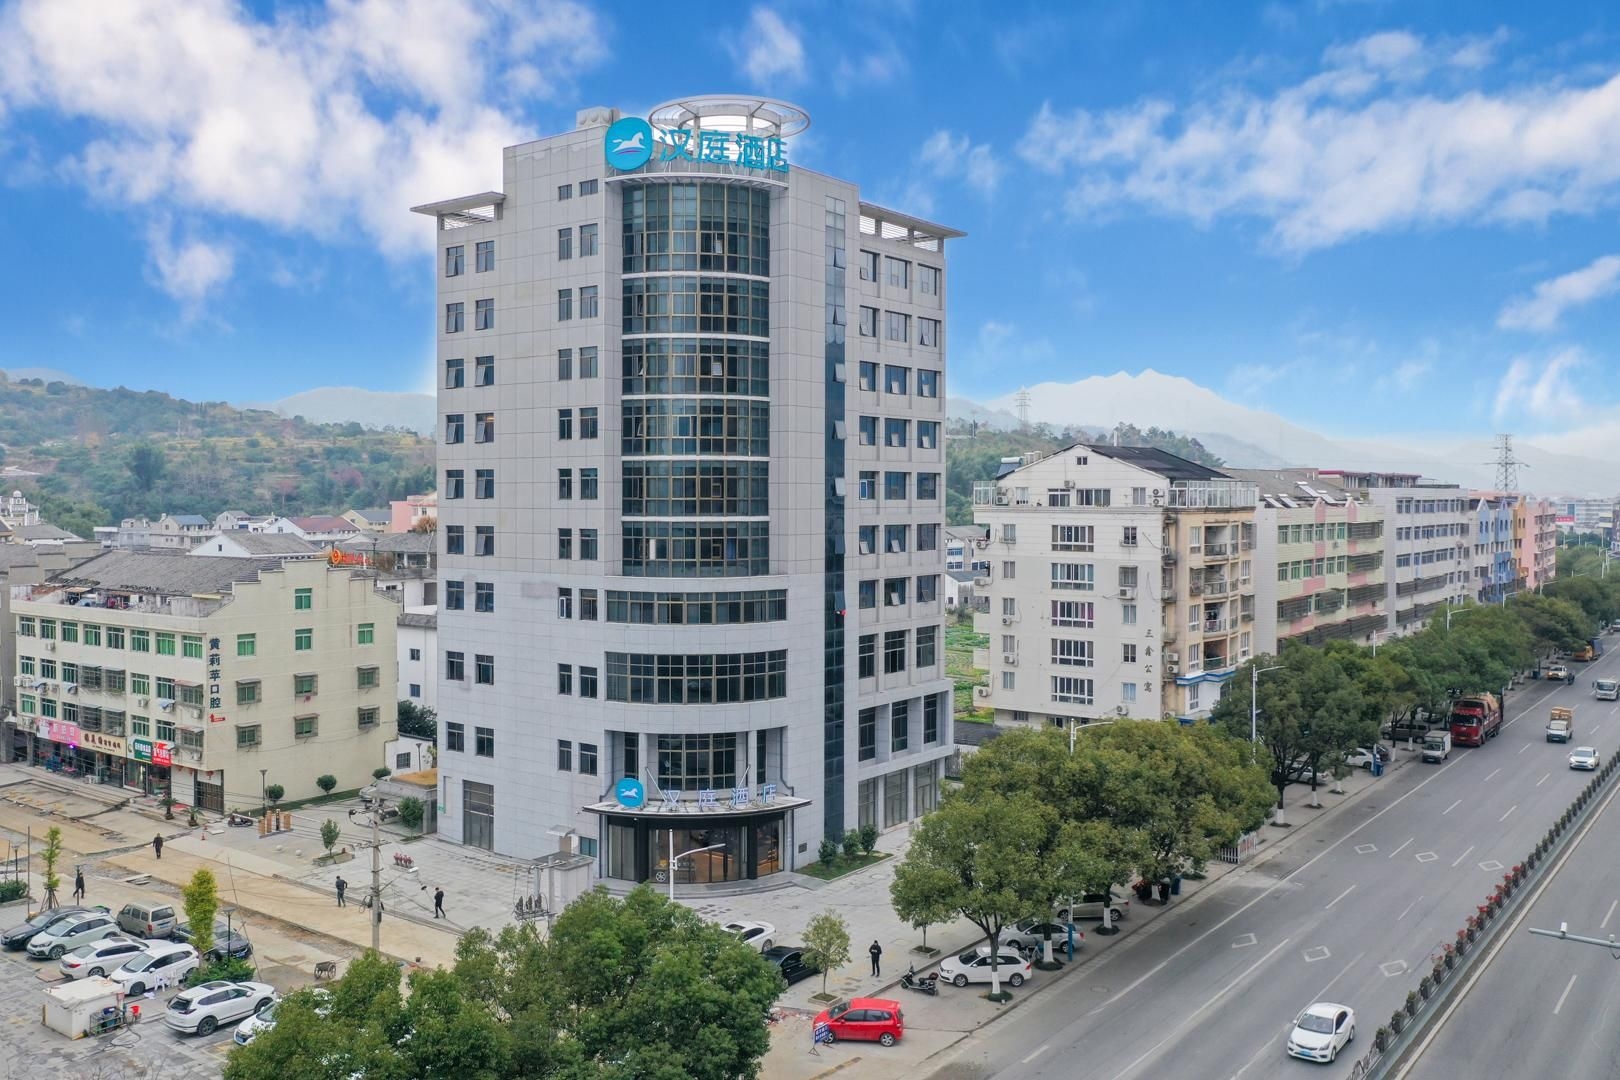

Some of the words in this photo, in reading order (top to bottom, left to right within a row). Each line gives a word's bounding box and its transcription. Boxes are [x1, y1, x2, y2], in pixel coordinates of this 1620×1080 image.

[659, 128, 789, 173] 汉庭酒店
[209, 637, 222, 709] 黄莉苹口腔
[663, 783, 777, 808] 汉庭酒店
